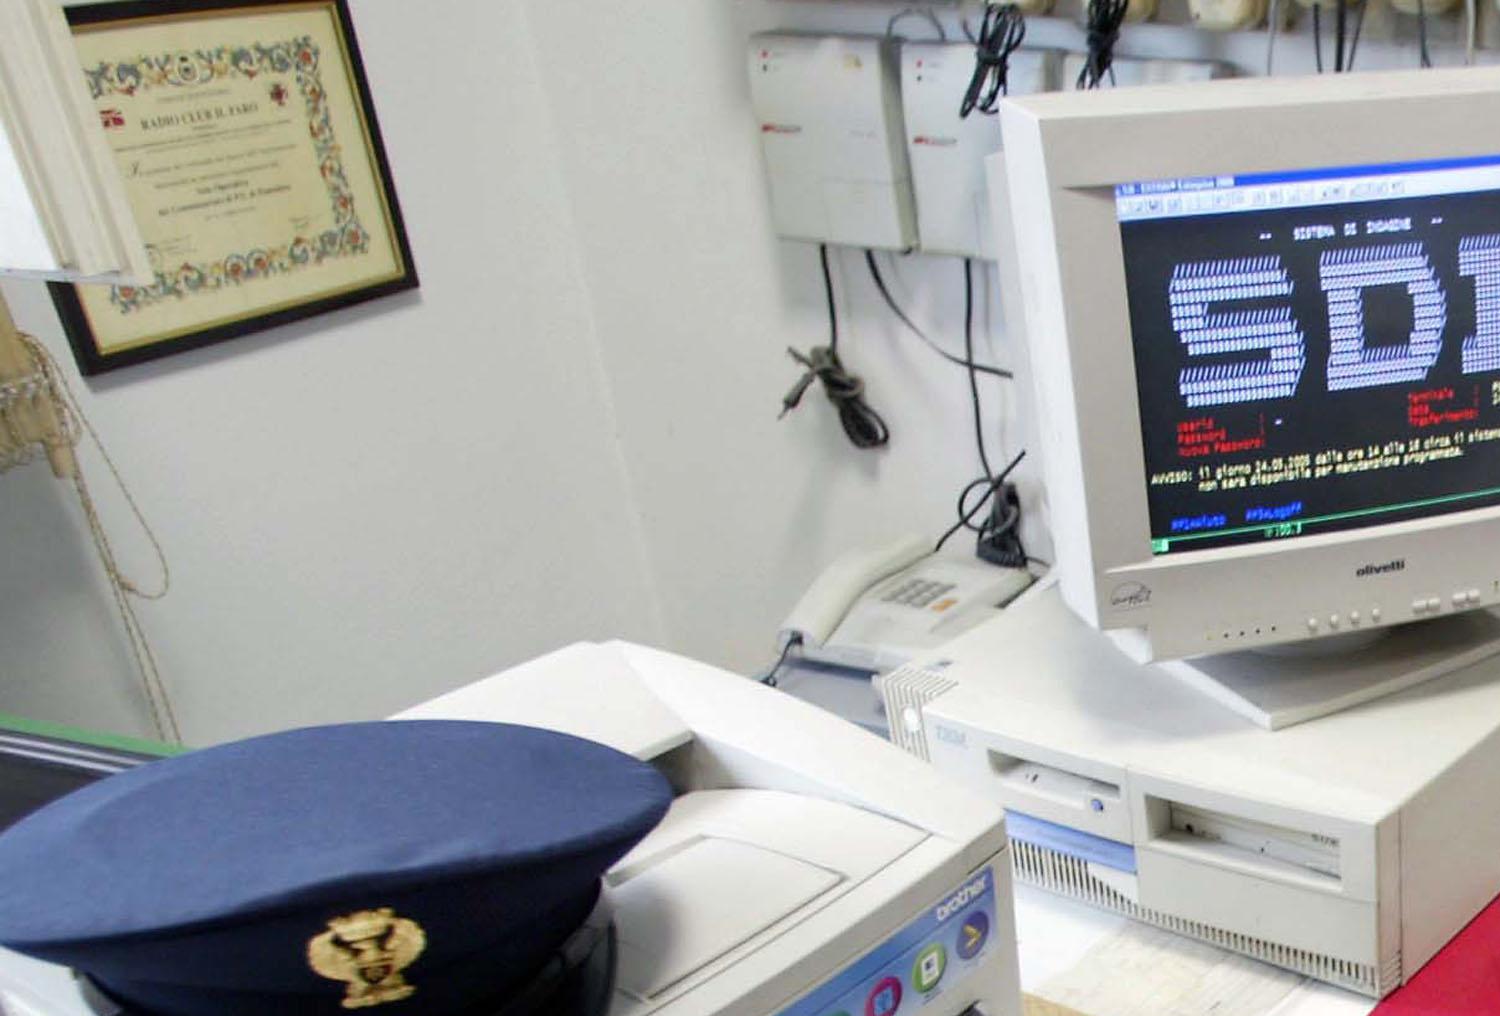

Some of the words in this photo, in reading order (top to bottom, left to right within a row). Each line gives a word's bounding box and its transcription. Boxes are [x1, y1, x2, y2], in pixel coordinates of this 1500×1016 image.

[140, 114, 180, 130] RADIO
[1356, 559, 1405, 578] olivetti
[936, 873, 986, 921] brother
